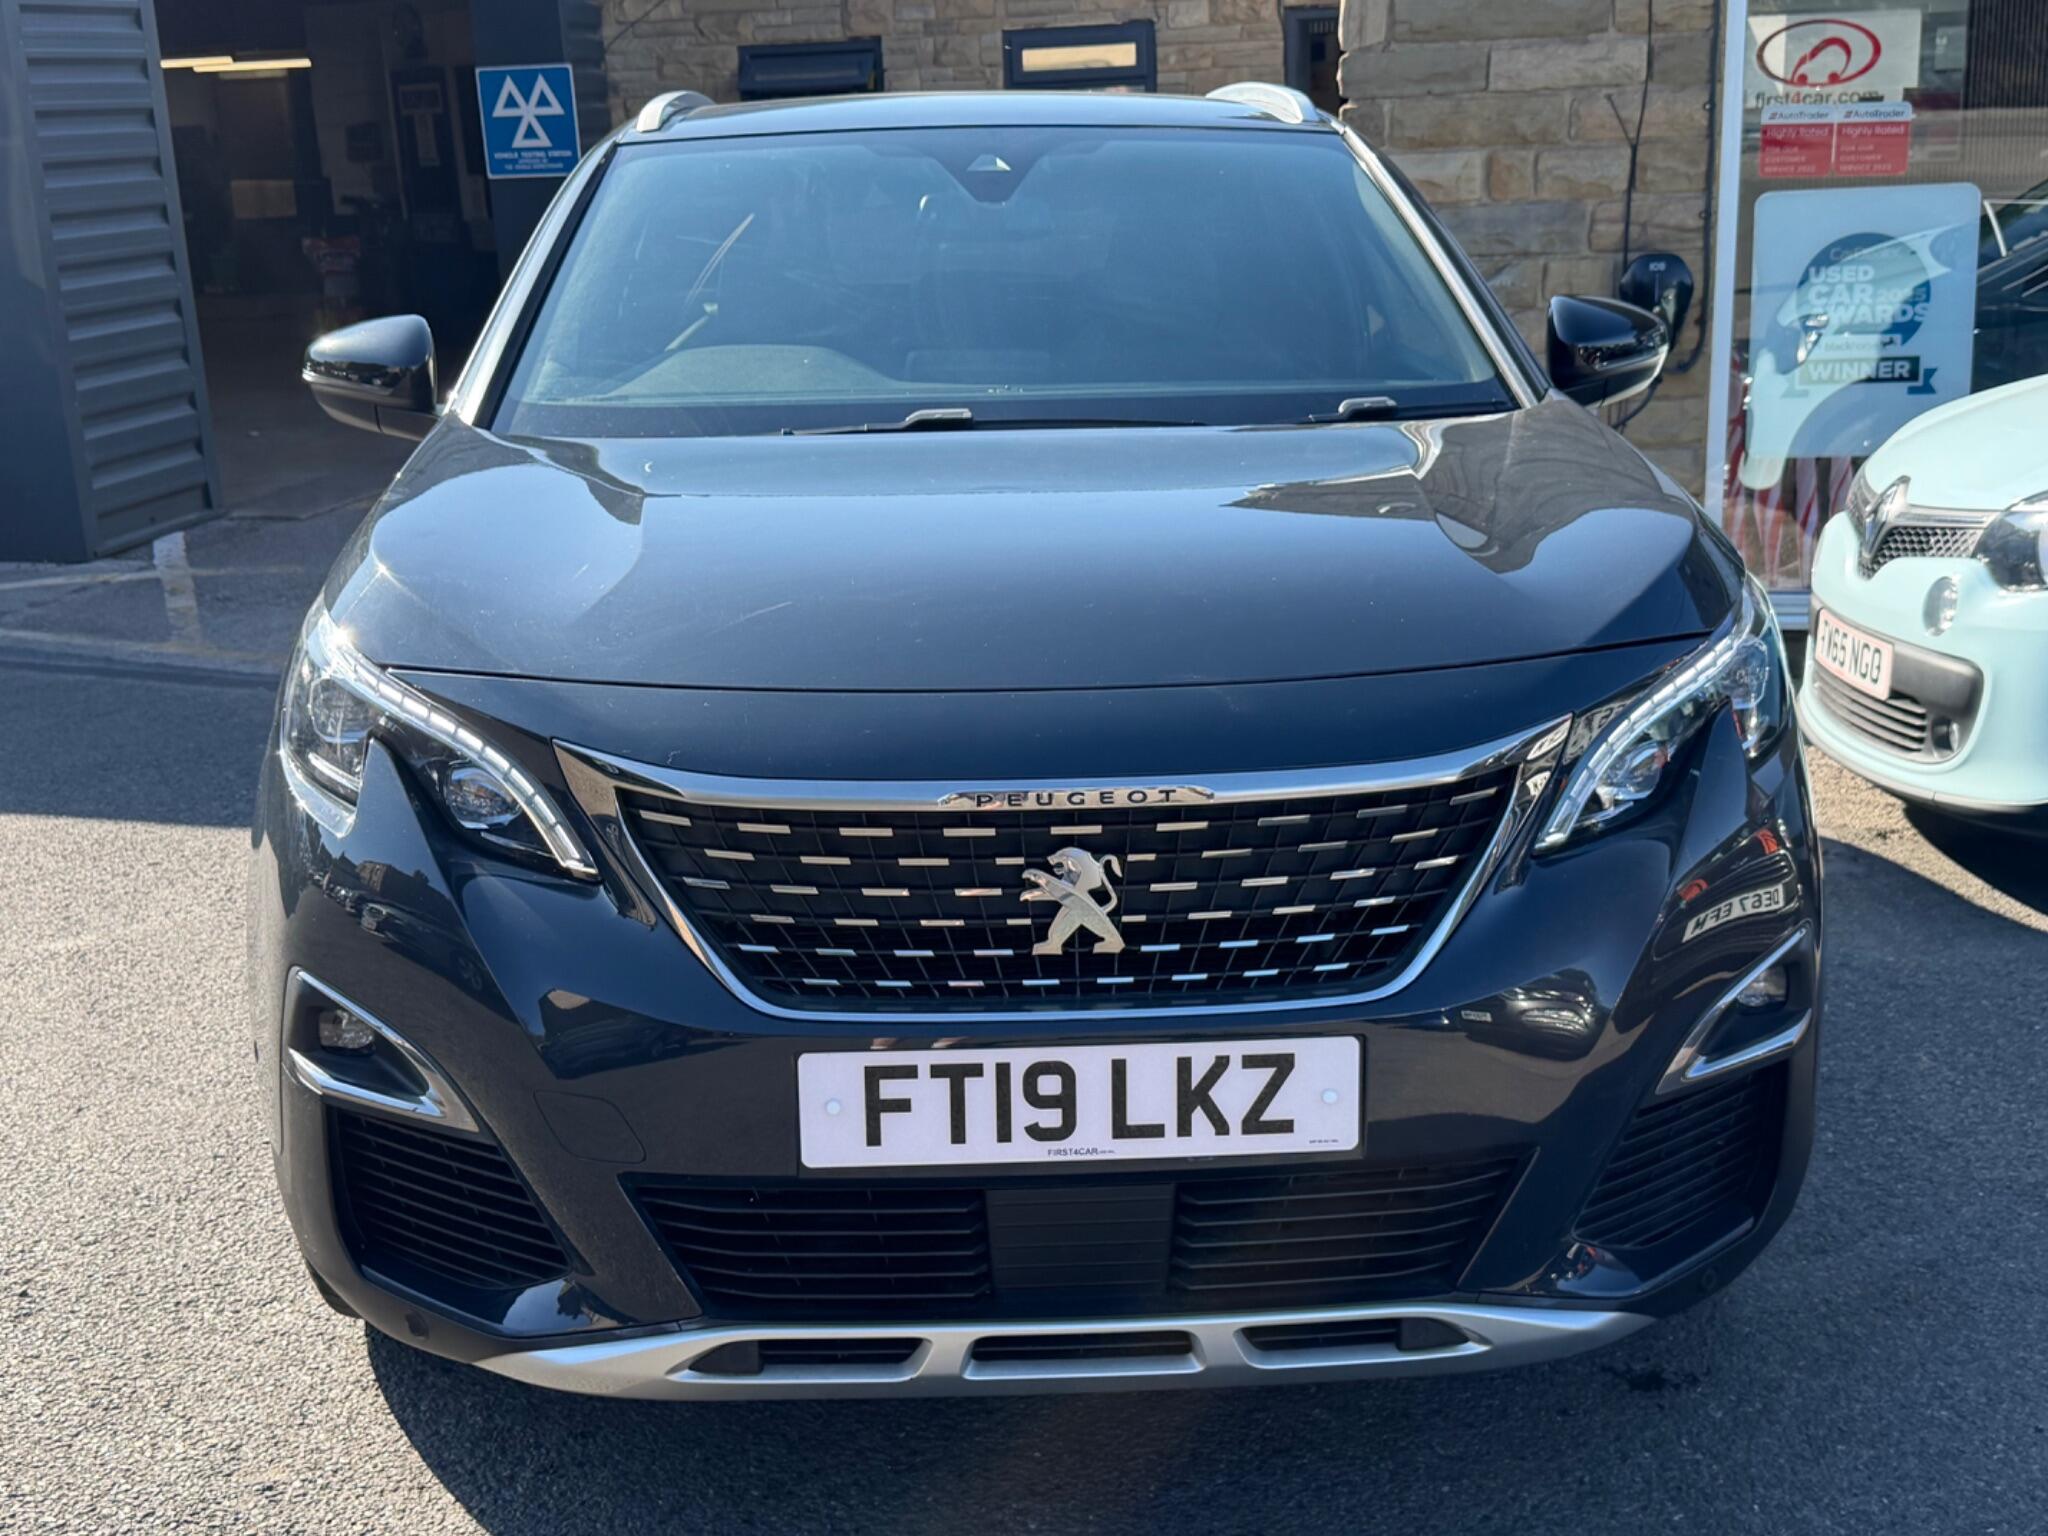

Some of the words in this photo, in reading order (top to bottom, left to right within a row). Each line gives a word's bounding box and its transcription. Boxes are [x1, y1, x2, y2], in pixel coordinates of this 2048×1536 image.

[1808, 265, 1875, 283] USED
[1807, 283, 1874, 305] CAR
[1807, 360, 1911, 381] WINNER
[975, 788, 1178, 808] PEUGEOT
[863, 1059, 1079, 1148] FT19
[1110, 1052, 1297, 1141] LKZ
